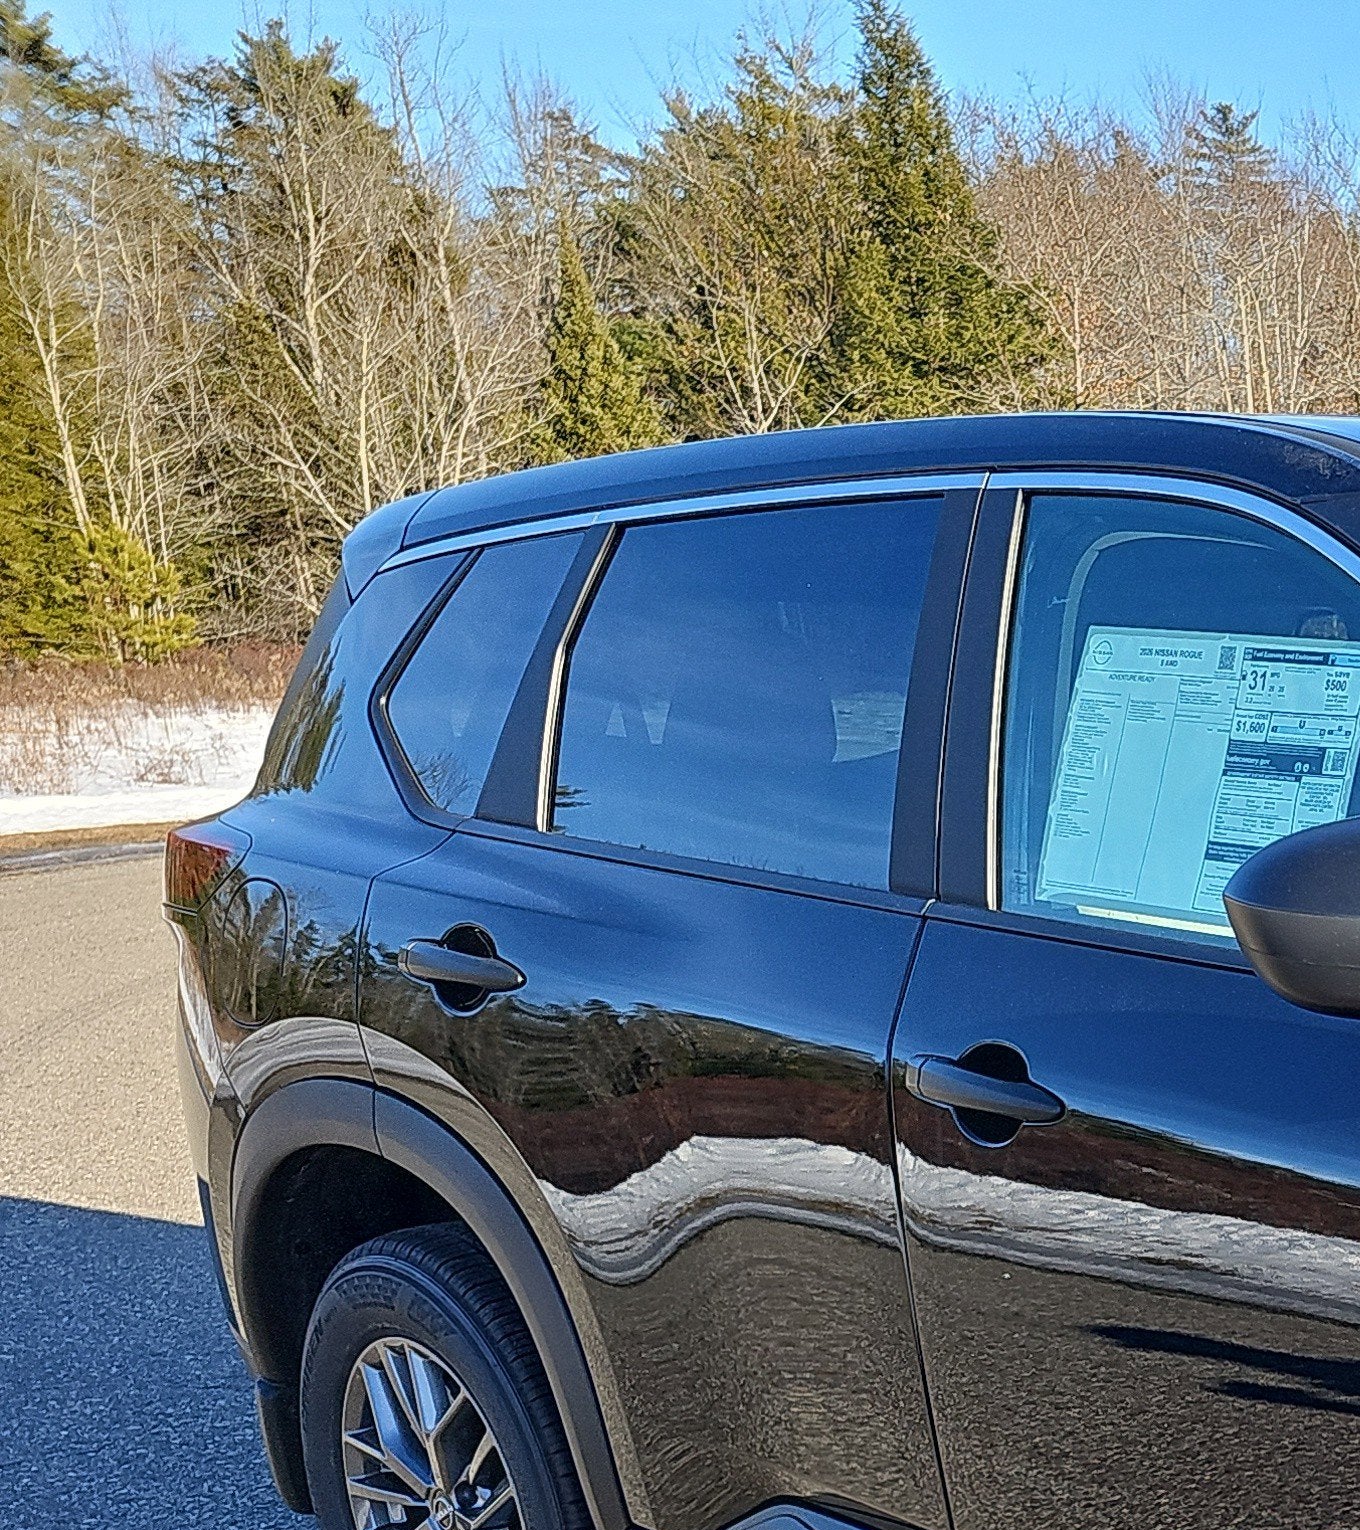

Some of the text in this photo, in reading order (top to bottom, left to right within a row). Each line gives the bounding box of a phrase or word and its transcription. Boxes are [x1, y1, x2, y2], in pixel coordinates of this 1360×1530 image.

[1154, 649, 1178, 658] NISSAN
[1179, 651, 1203, 659] ROGUE
[1248, 670, 1267, 691] 31
[1325, 679, 1347, 692] $500
[1235, 720, 1266, 734] $1,600
